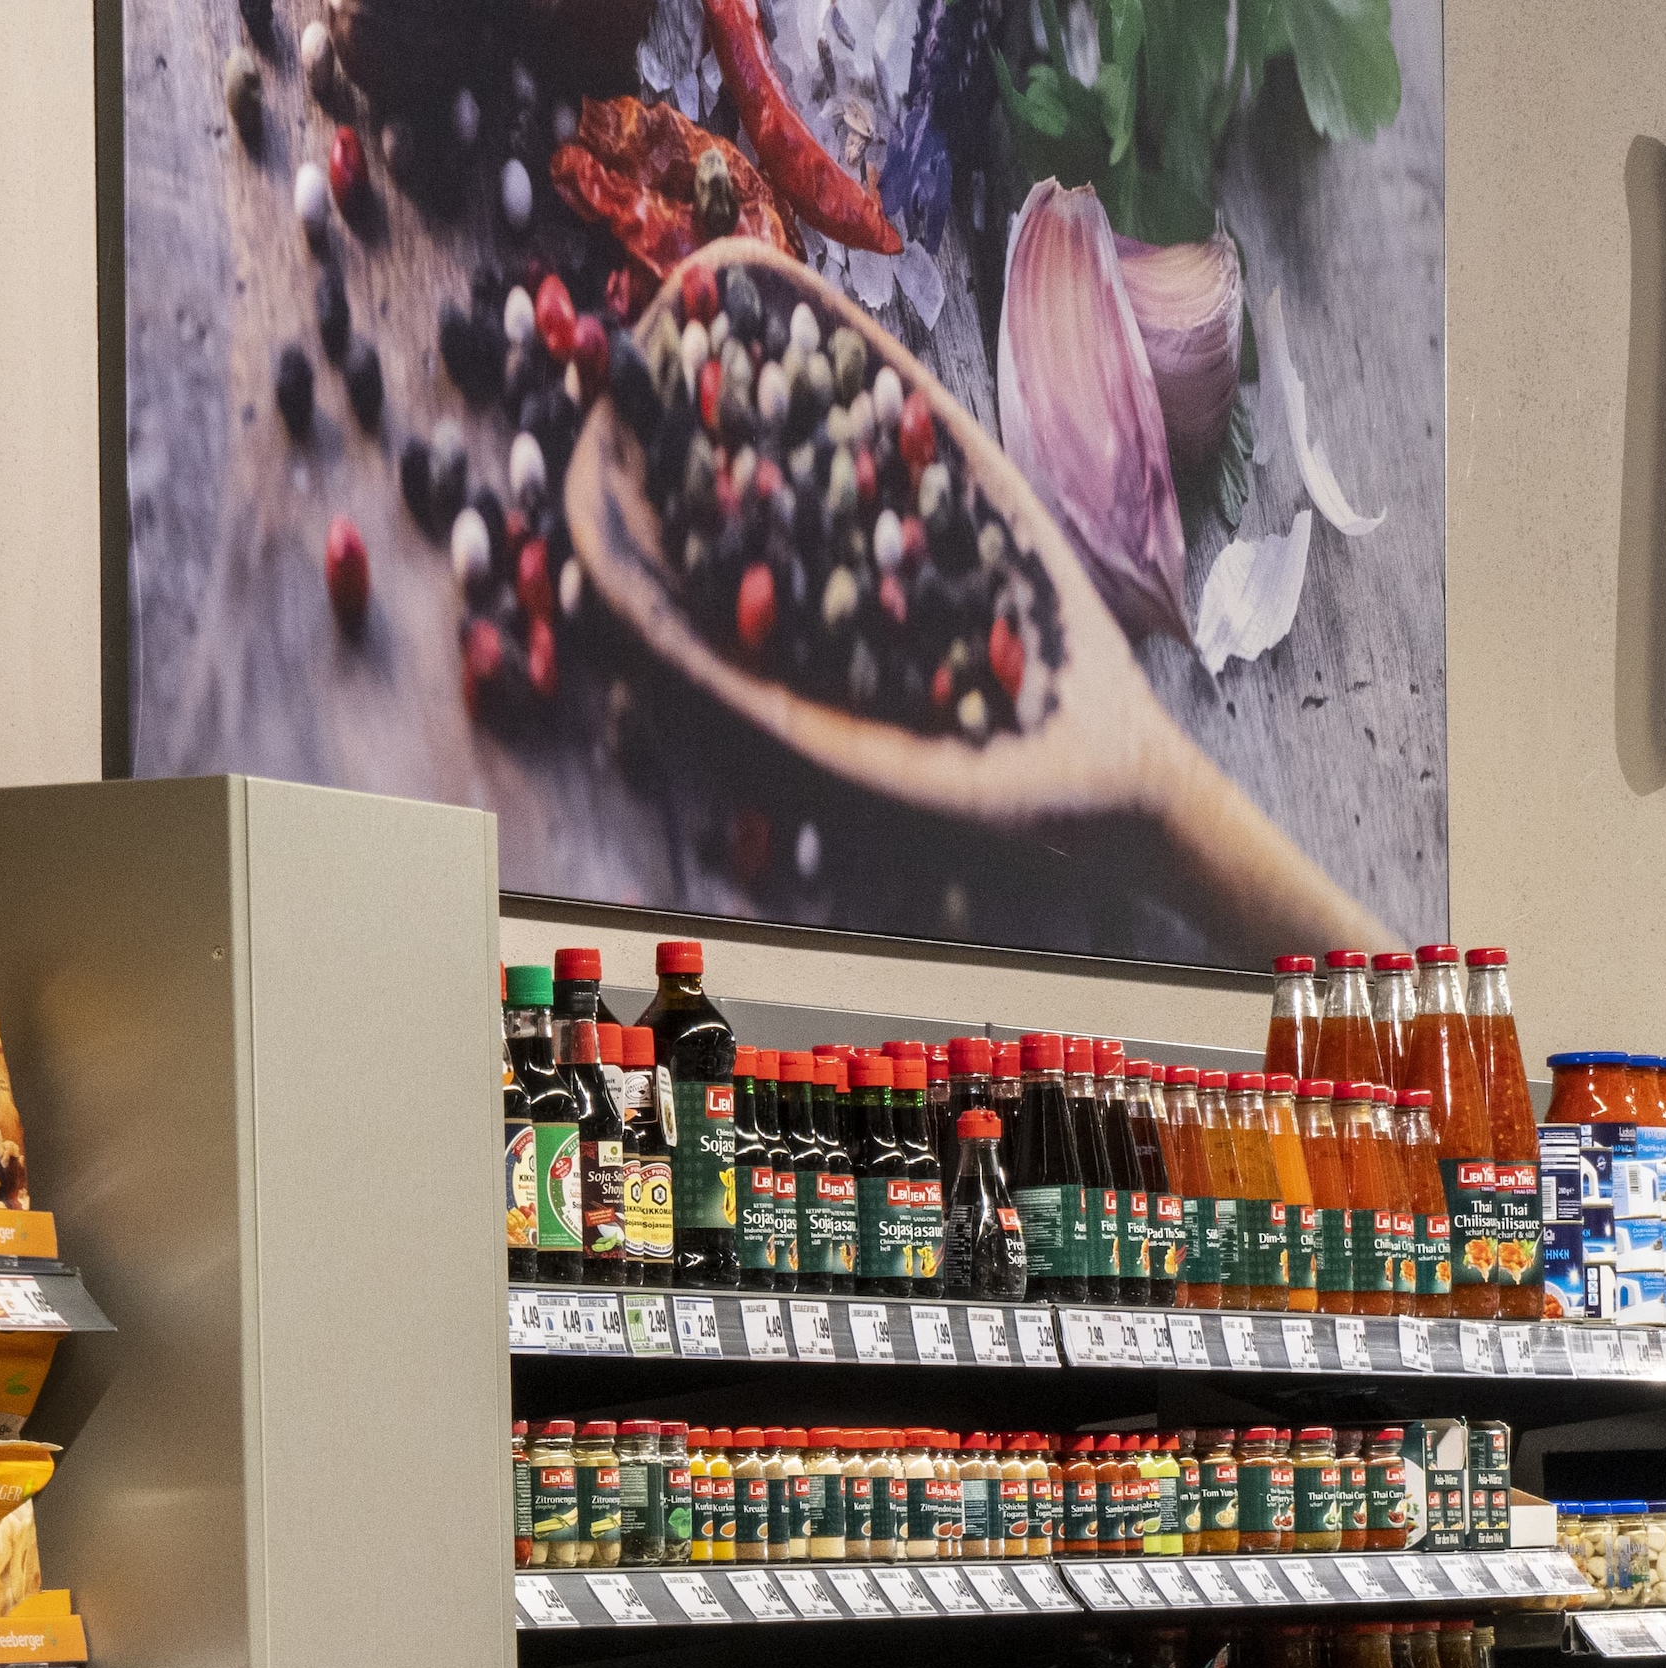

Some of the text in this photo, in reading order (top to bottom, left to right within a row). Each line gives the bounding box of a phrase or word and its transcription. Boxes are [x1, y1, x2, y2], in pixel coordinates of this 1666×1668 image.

[1517, 1172, 1535, 1186] YING
[1472, 1201, 1492, 1212] Thai
[1501, 1204, 1528, 1216] Thai
[521, 1307, 540, 1328] 4.49
[563, 1311, 581, 1333] 4.49
[603, 1312, 620, 1334] 4.49
[648, 1311, 666, 1332] 2.99
[698, 1316, 716, 1337] 2.39
[766, 1317, 783, 1337] 4.49
[813, 1317, 830, 1338] 1.99
[630, 1324, 644, 1341] BIO
[873, 1322, 889, 1343] 1.99
[934, 1323, 951, 1344] 1.99
[989, 1325, 1006, 1346] 2.29
[1037, 1326, 1054, 1347] 3.29
[1088, 1326, 1104, 1346] 2.99
[1153, 1326, 1169, 1347] 2.79
[1188, 1330, 1203, 1350] 2.79
[543, 1472, 560, 1483] LIEN
[1449, 1534, 1459, 1544] Wok
